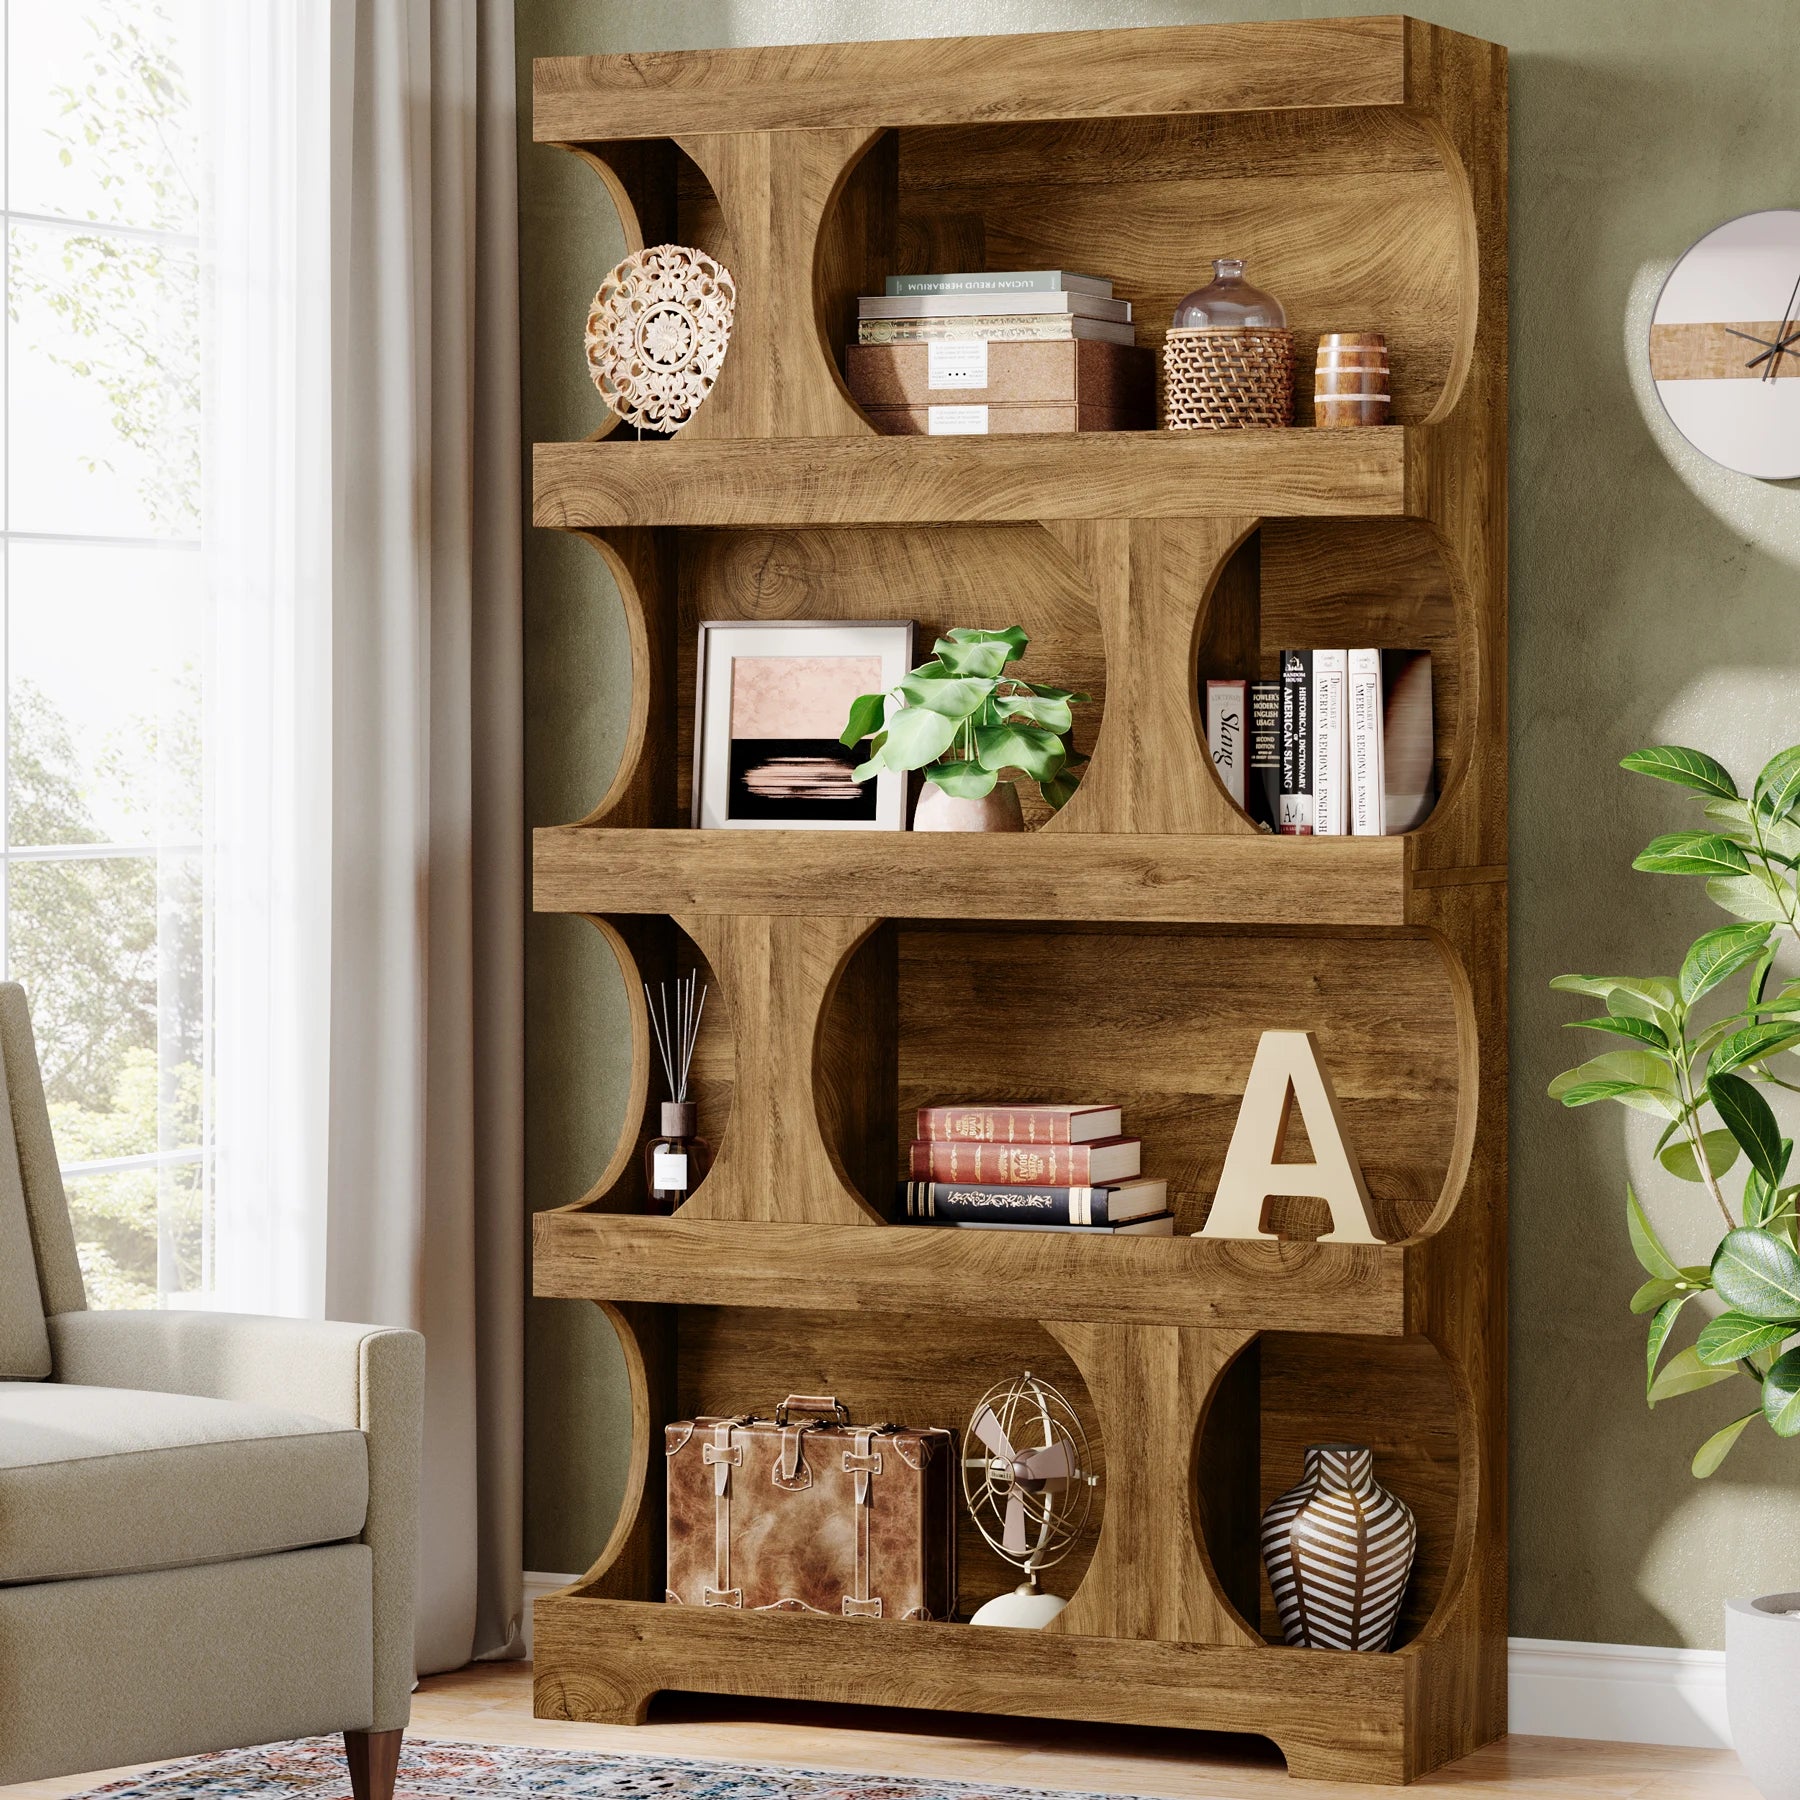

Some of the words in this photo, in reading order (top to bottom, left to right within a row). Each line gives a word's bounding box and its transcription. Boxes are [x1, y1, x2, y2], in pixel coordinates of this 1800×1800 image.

[908, 282, 963, 291] HERBARIUM
[965, 281, 996, 290] FREUD
[998, 280, 1034, 289] LUCIAN
[1253, 702, 1279, 710] MODERN
[1253, 710, 1278, 718] ENGLISH
[1284, 687, 1292, 747] AMERICAN
[1299, 687, 1307, 737] HISTORICAL
[1319, 678, 1328, 730] AMERICAN
[1355, 683, 1365, 731] AMERICAN
[1213, 709, 1239, 768] Slang
[1318, 733, 1328, 784] REGIONAL
[1356, 735, 1366, 782] REGIONAL
[1284, 750, 1292, 789] SLANG
[1298, 739, 1306, 789] DICTIONARY
[1318, 788, 1328, 833] ENGLISH
[1358, 785, 1367, 827] ENGLISH
[1191, 1030, 1387, 1245] A
